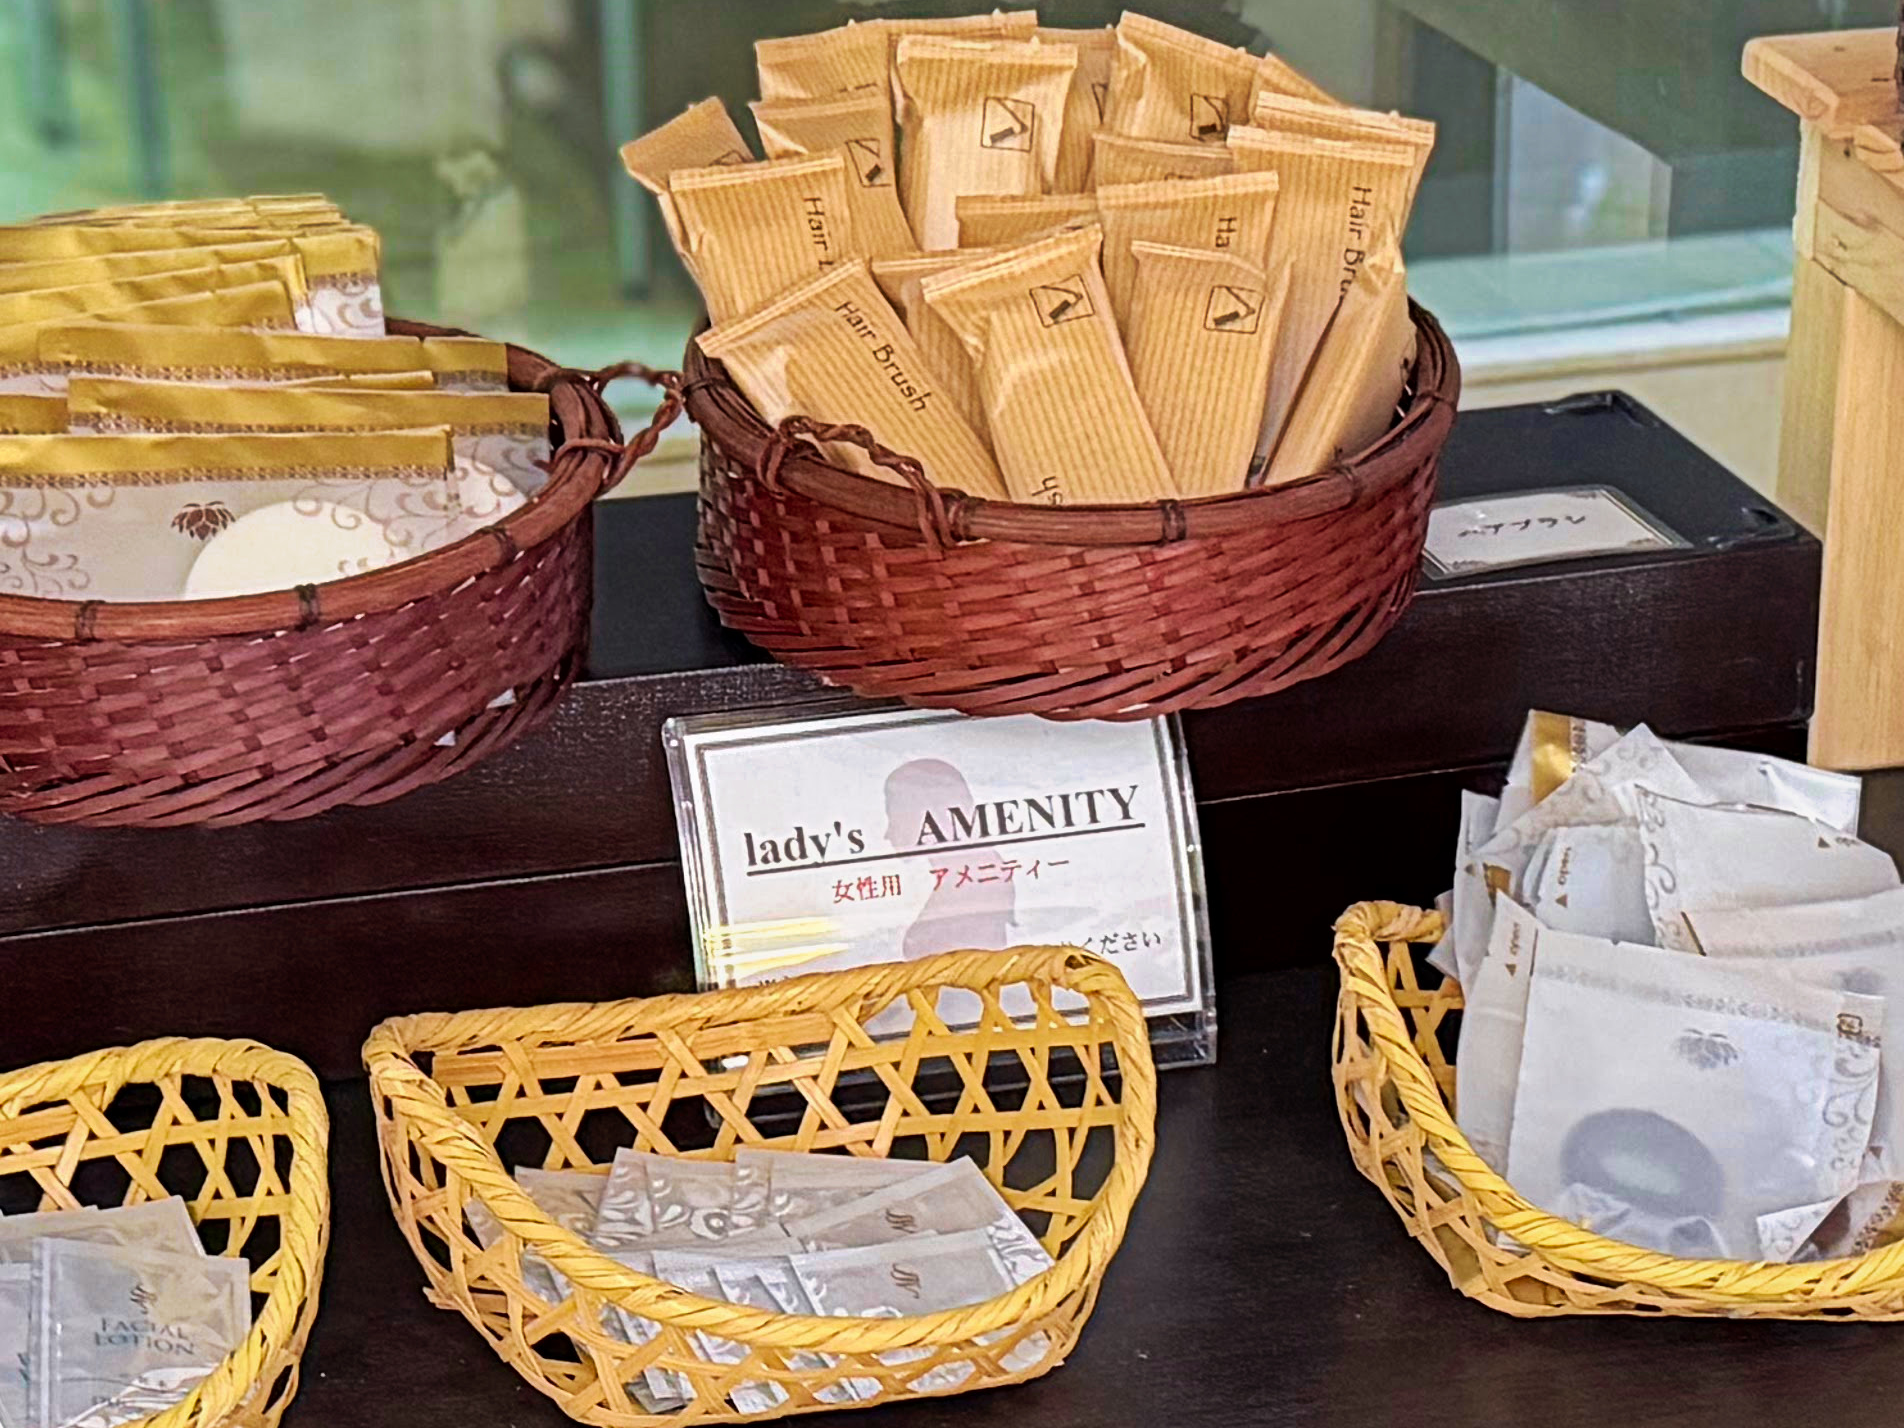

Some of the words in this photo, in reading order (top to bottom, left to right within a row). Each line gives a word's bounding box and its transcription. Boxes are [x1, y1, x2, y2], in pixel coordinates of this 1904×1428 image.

[803, 196, 828, 251] Hair
[1349, 186, 1373, 240] Hair
[1340, 247, 1366, 294] Bru
[834, 300, 876, 340] Hair
[872, 343, 932, 412] Brush
[743, 821, 865, 868] lady's
[916, 785, 1139, 846] AMENITY
[831, 874, 903, 904] 女性用
[929, 858, 1071, 892] アメニティー
[94, 1331, 195, 1356] LOTION
[101, 1317, 190, 1341] FACIAL
